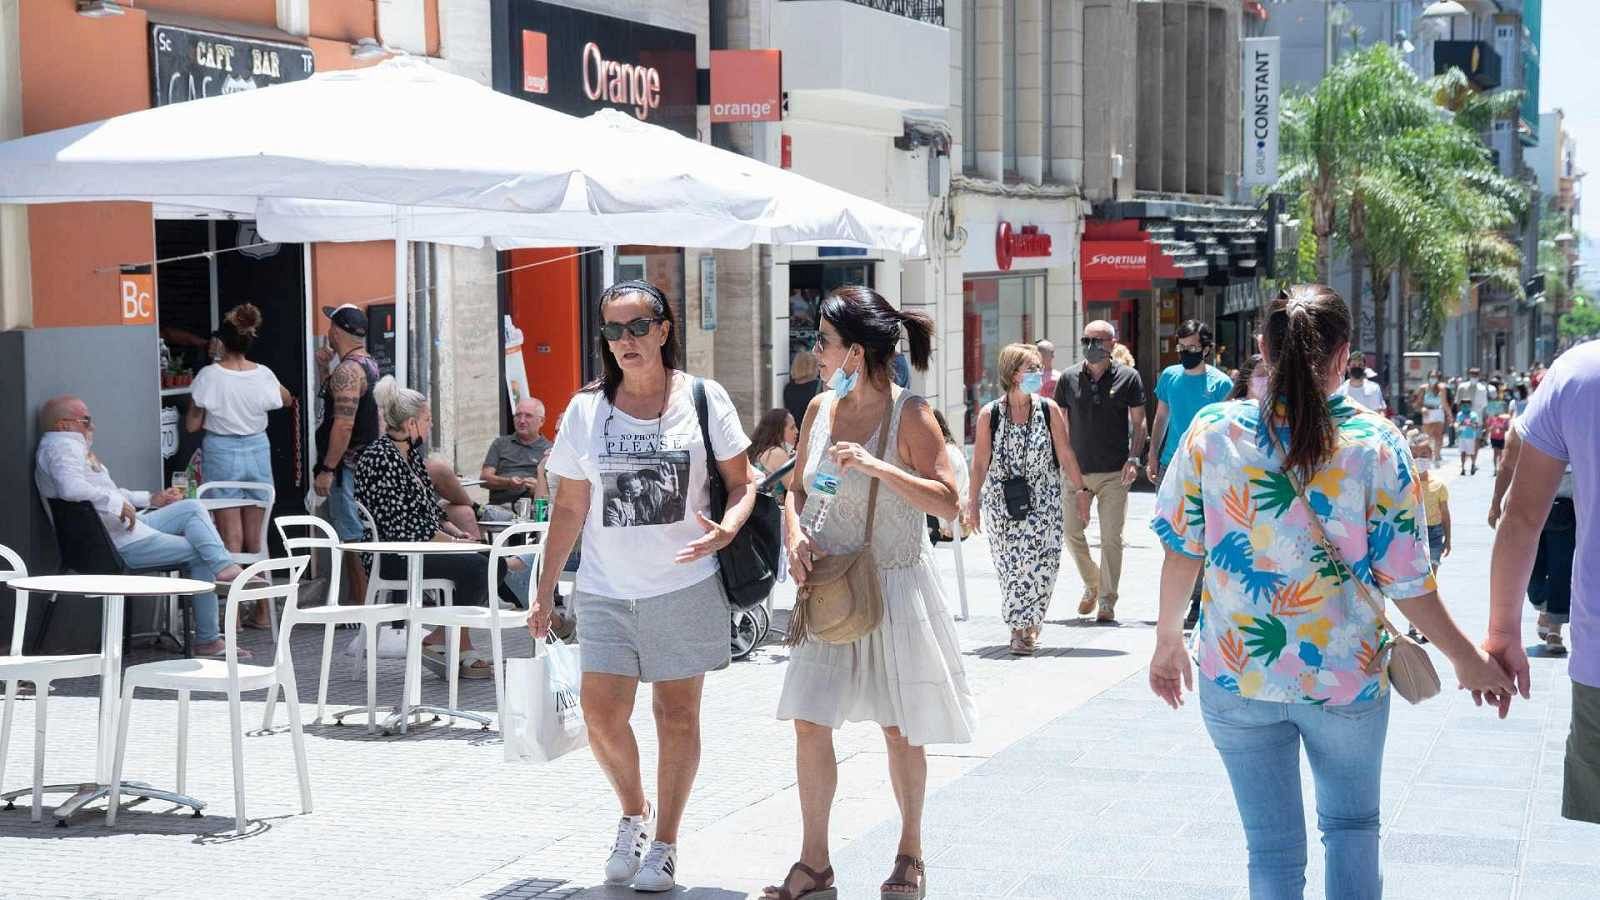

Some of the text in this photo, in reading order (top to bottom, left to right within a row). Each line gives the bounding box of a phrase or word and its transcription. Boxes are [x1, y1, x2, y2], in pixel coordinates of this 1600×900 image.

[159, 32, 172, 51] Sc
[252, 49, 281, 78] BAR
[583, 42, 660, 120] Orange
[1254, 50, 1270, 140] CONSTANT
[714, 103, 771, 119] orange
[1086, 254, 1146, 266] SPORTIUM
[123, 280, 150, 318] Bc
[608, 440, 682, 452] PLEASE
[620, 433, 632, 441] NO
